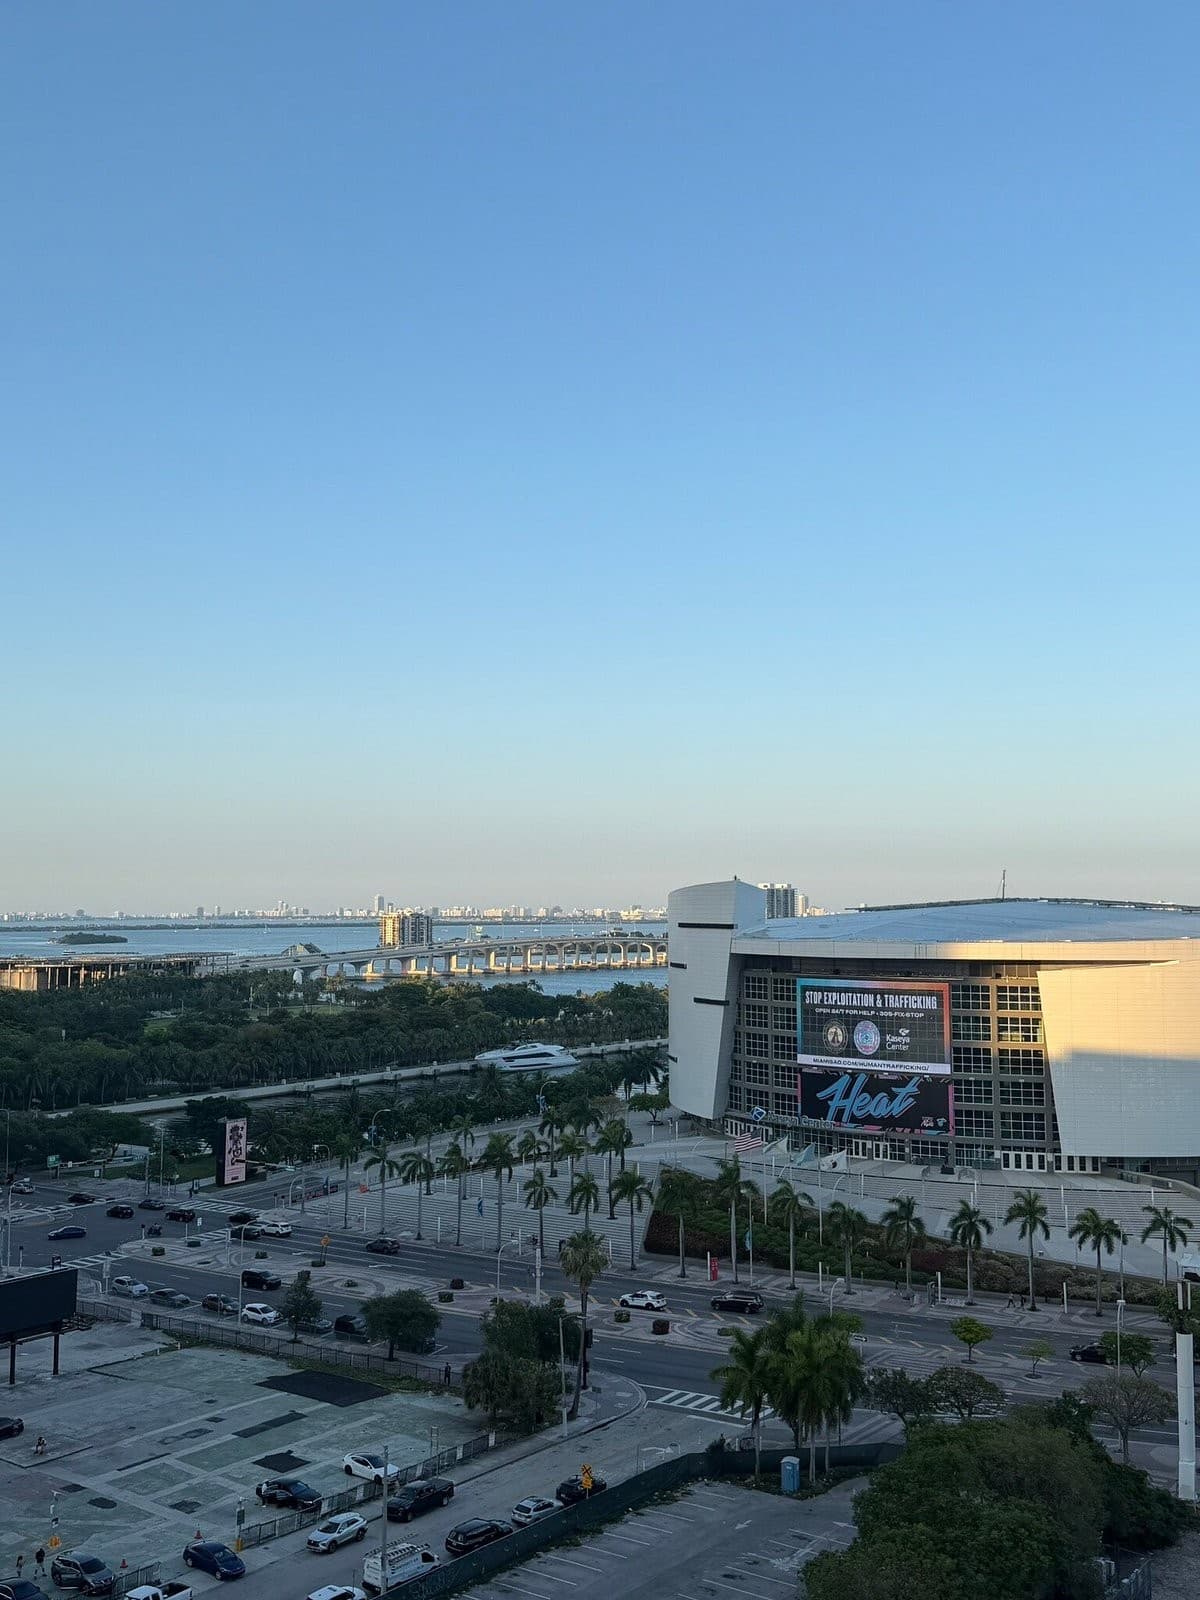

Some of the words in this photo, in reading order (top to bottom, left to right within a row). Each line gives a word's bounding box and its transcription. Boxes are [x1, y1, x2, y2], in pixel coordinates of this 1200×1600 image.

[805, 991, 822, 1004] STOP
[824, 991, 874, 1007] EXPLOITATION
[876, 994, 882, 1007] &
[884, 994, 937, 1009] TRAFFICKING
[886, 1034, 910, 1044] Kaseya
[886, 1042, 909, 1051] Center
[816, 1073, 921, 1123] Heat
[802, 1115, 835, 1129] Center
